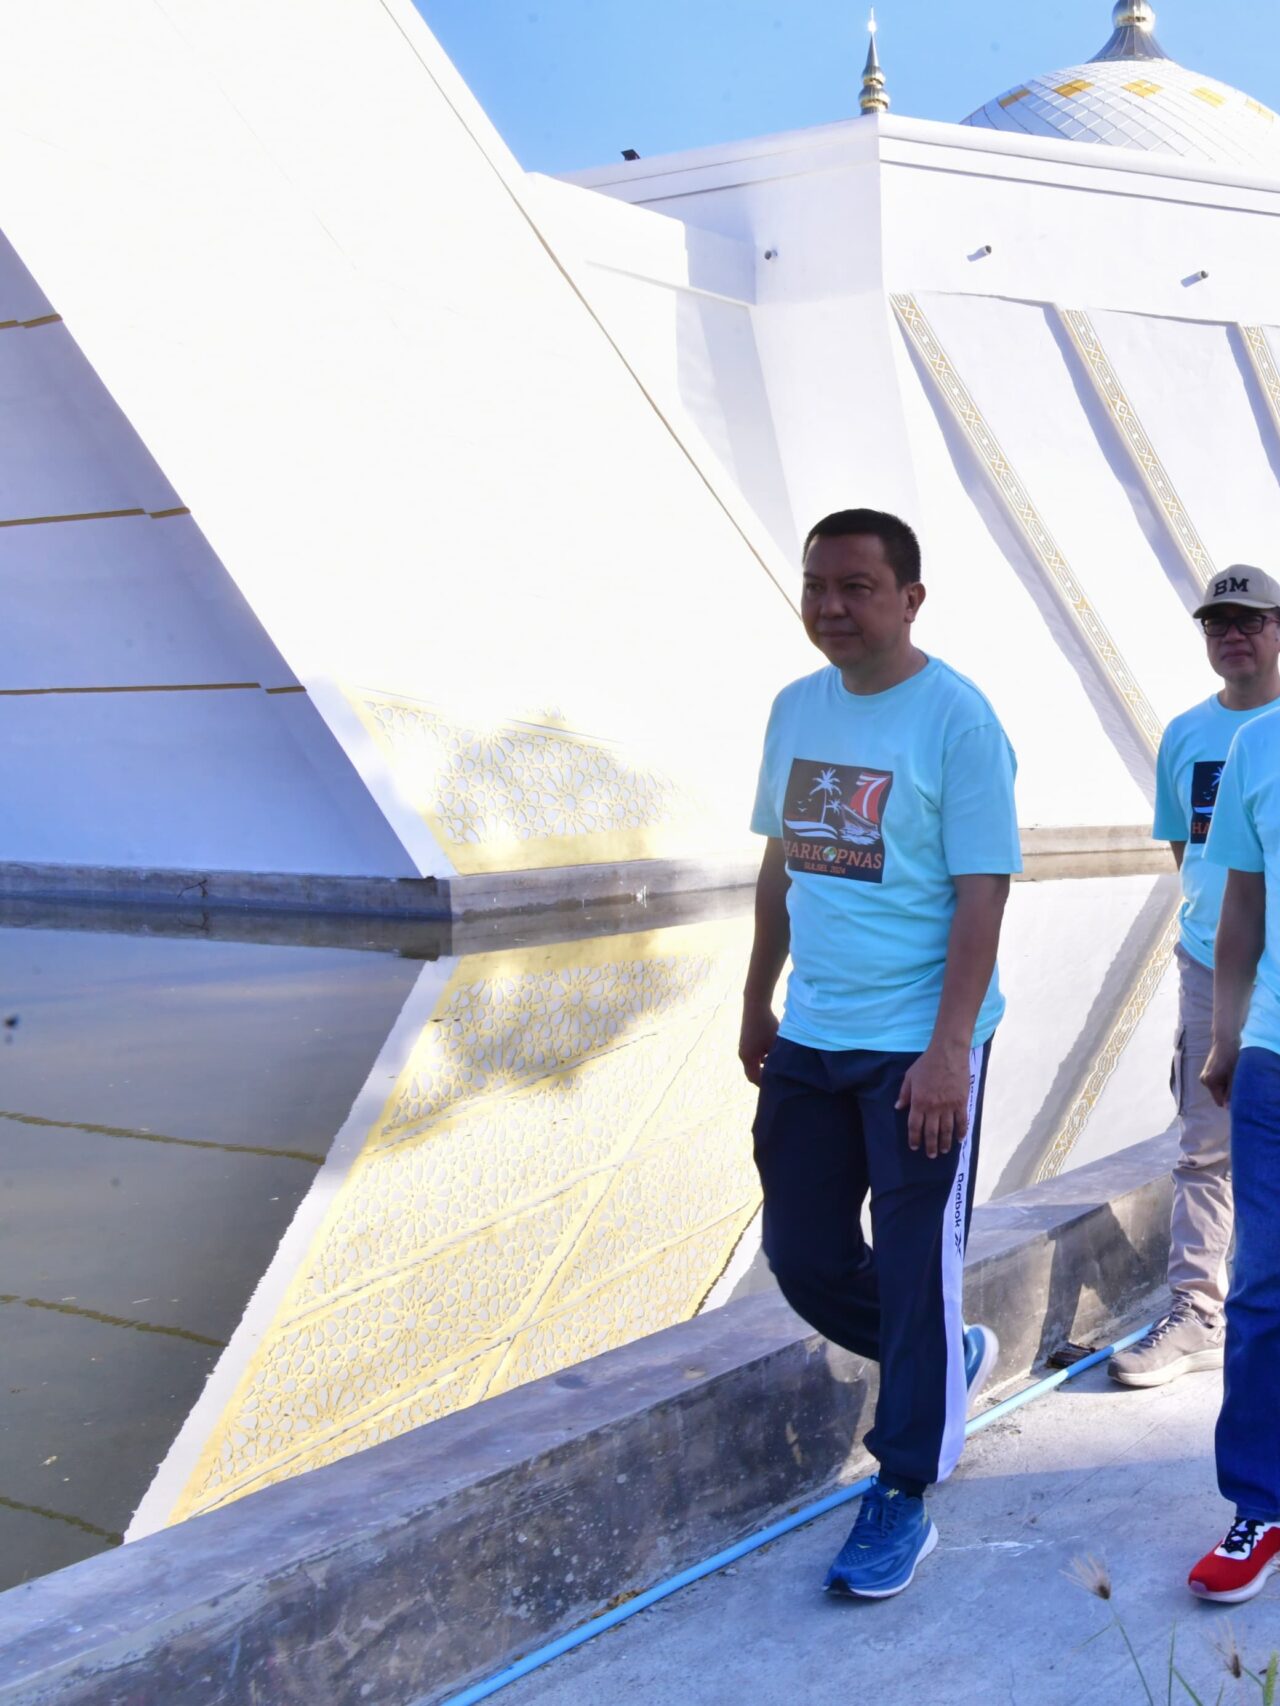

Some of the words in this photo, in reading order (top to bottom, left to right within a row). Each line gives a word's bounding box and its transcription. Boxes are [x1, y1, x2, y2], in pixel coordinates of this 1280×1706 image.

[1213, 577, 1250, 597] BM
[784, 840, 882, 869] HARKOPNAS
[954, 1172, 964, 1228] Reebok
